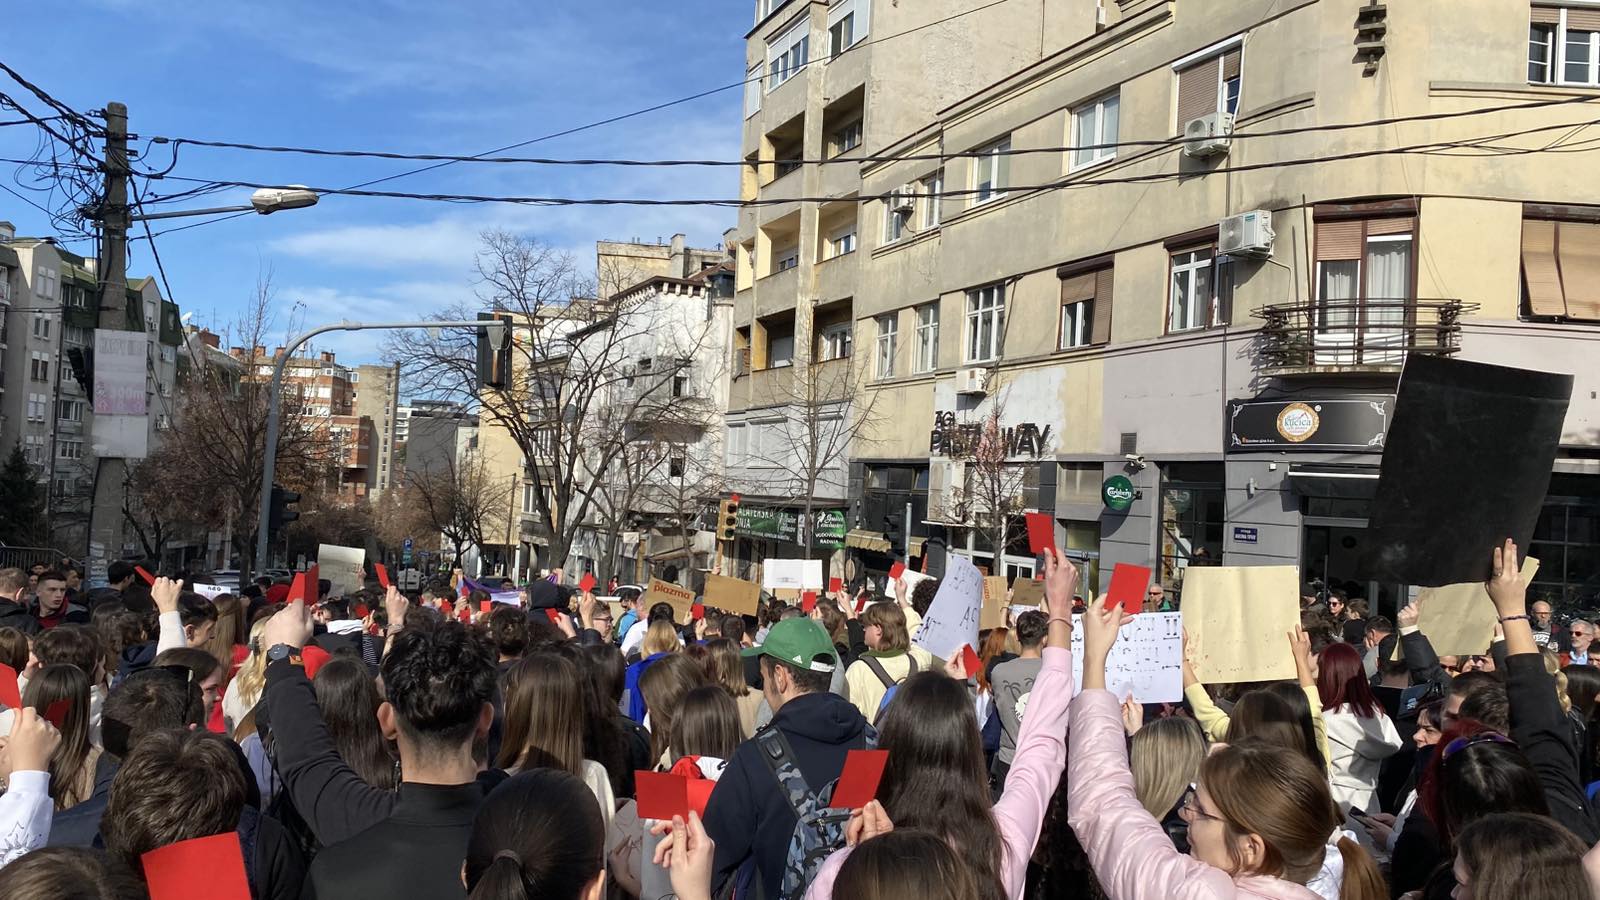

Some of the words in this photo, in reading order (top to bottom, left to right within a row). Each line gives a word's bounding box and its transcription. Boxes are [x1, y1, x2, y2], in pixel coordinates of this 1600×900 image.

[1001, 422, 1051, 459] WAY
[1107, 486, 1131, 500] Carlsberg
[653, 583, 691, 600] plazma
